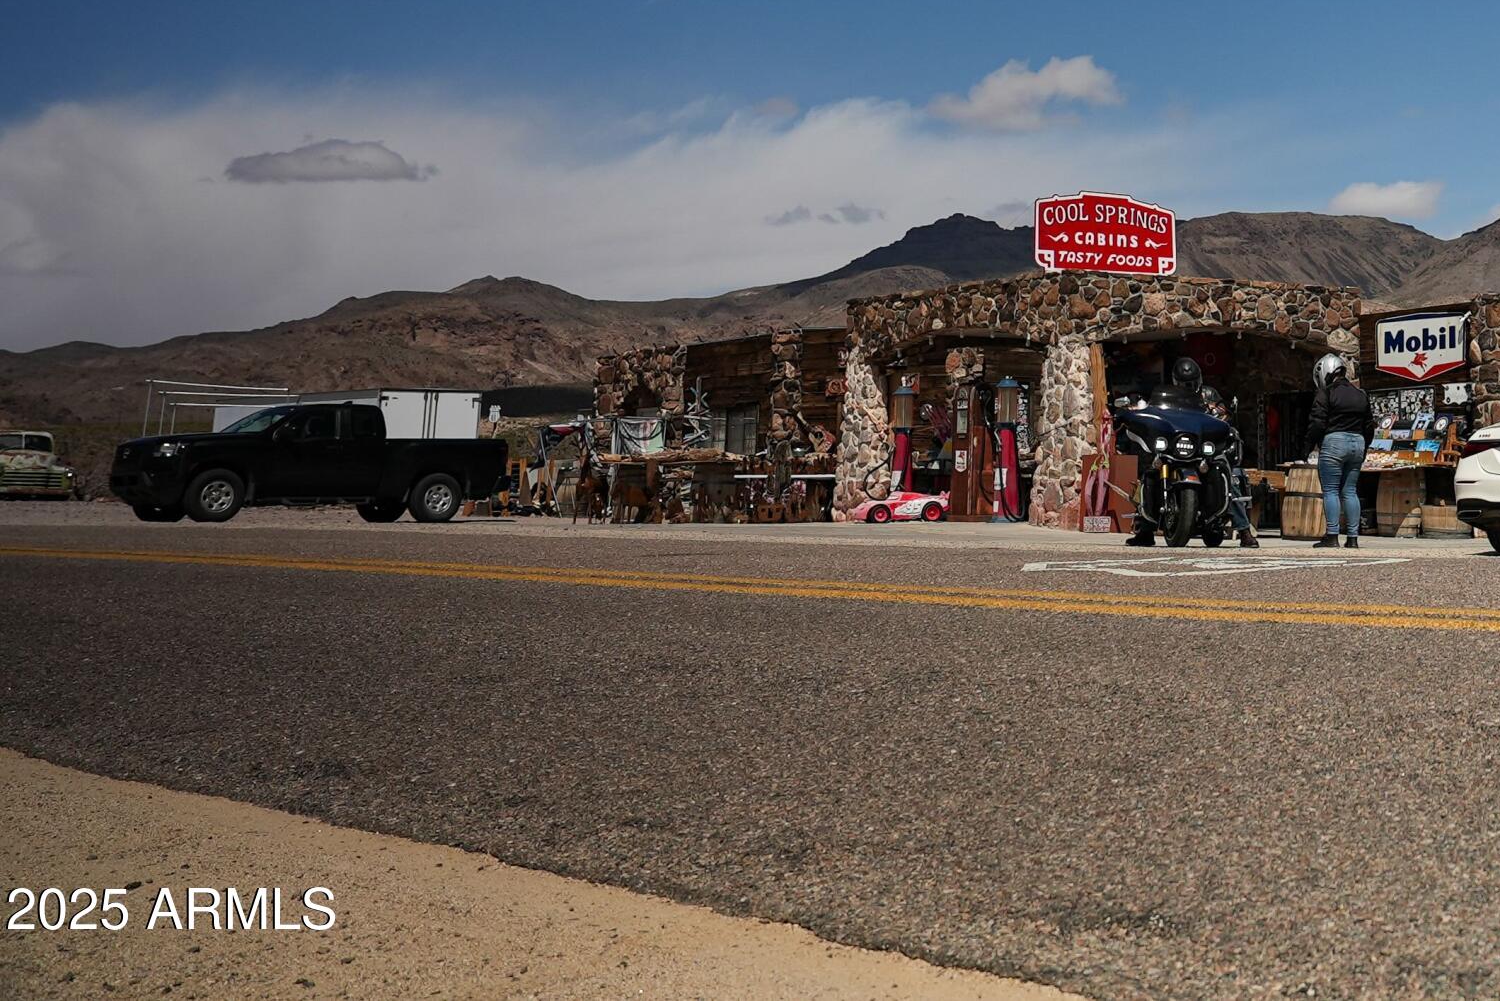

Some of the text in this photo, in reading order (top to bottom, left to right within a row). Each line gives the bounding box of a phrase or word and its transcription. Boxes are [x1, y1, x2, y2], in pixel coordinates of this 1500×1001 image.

[1043, 202, 1168, 234] COOL SPRINGS
[1058, 250, 1153, 267] TASTY FOODS
[1384, 325, 1456, 354] Mobil
